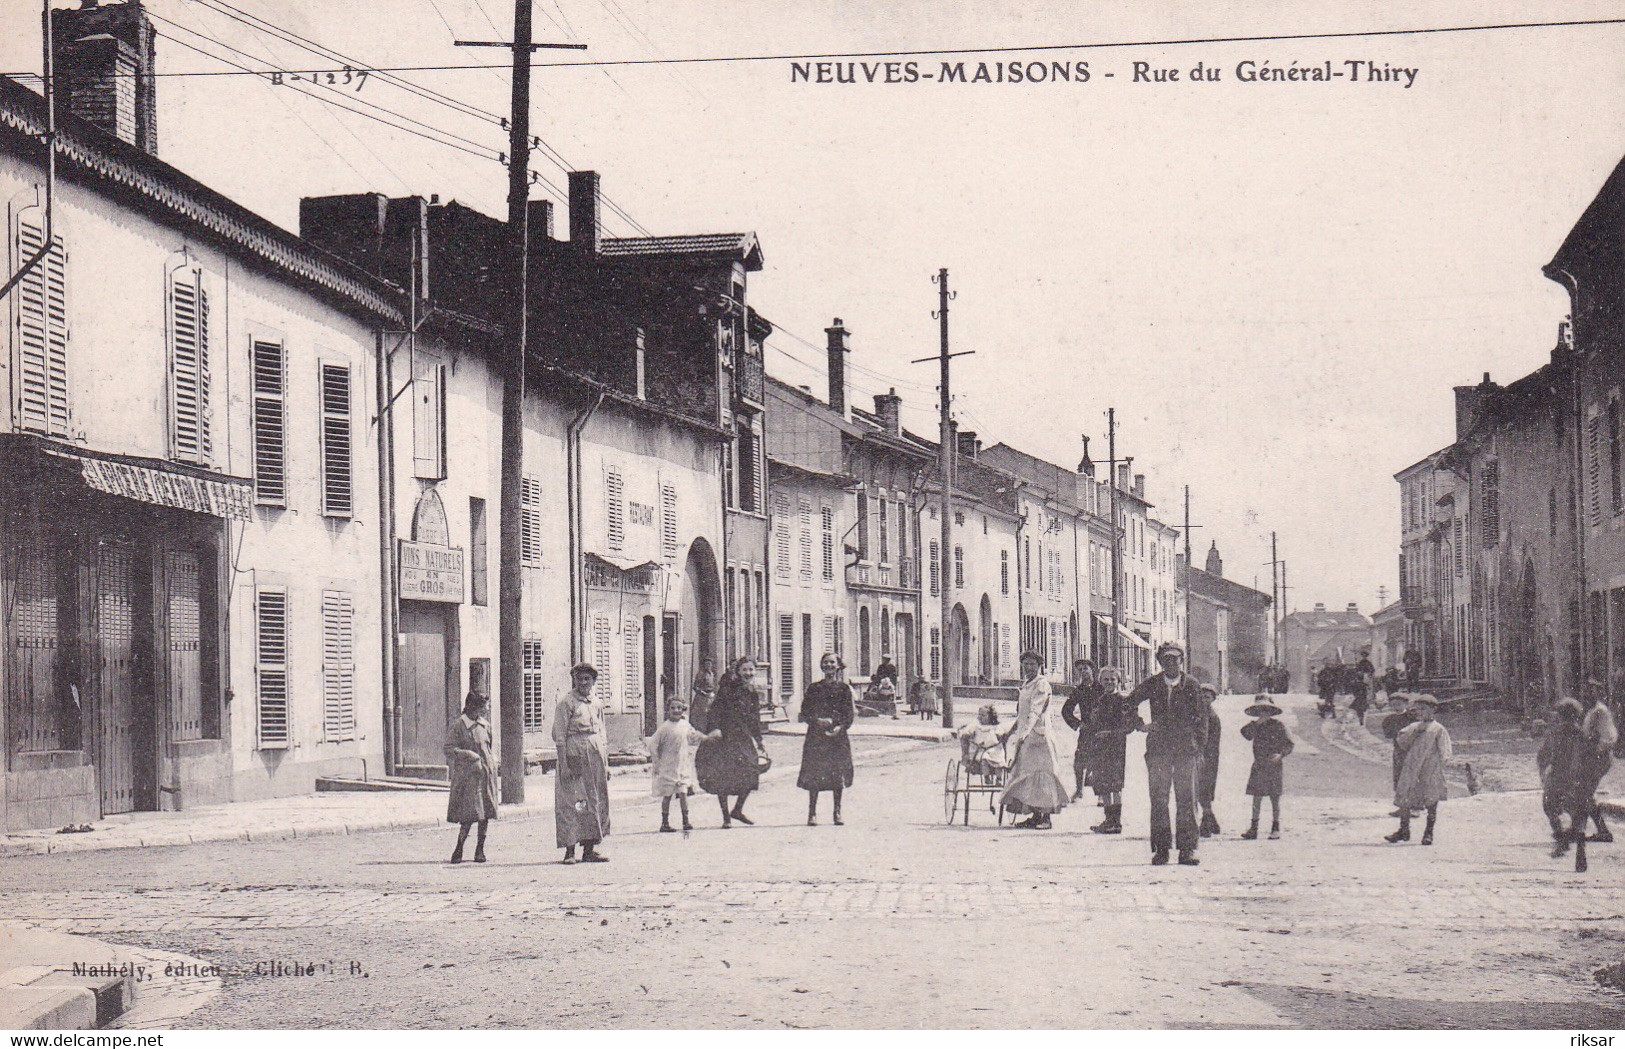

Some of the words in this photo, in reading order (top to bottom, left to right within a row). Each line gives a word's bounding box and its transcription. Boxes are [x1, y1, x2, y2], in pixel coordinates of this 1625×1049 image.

[403, 546, 420, 566] VINS
[425, 549, 461, 571] NATURELS
[420, 580, 444, 594] GROS
